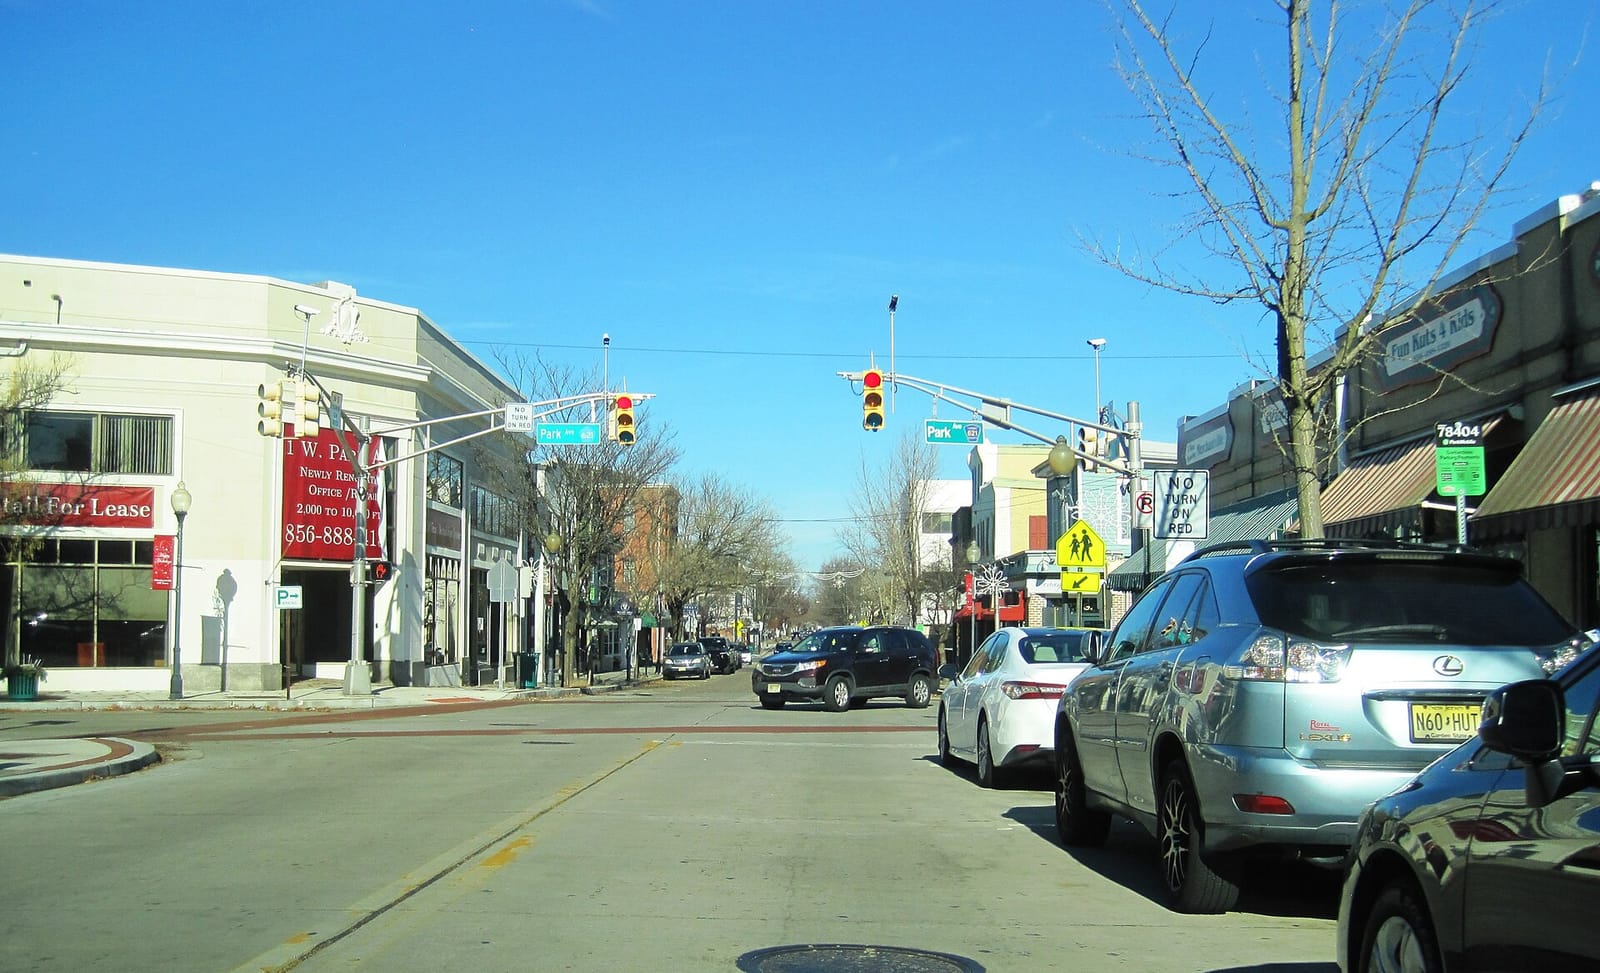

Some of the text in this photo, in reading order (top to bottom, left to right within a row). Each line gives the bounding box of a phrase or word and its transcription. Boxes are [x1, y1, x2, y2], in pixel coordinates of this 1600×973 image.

[1391, 342, 1410, 358] Fun
[1412, 328, 1437, 351] Kuts
[1439, 321, 1446, 338] 4
[1449, 309, 1474, 335] Kids
[540, 428, 562, 439] Park
[927, 425, 952, 438] Park
[1437, 425, 1480, 438] 78404
[287, 439, 294, 456] 1
[301, 440, 323, 459] W.
[1169, 476, 1194, 490] NO
[1165, 494, 1197, 504] TURN
[45, 496, 85, 516] For
[90, 498, 151, 518] Lease
[296, 503, 322, 516] 2,000
[1172, 508, 1190, 519] ON
[1169, 523, 1193, 534] RED
[1416, 712, 1478, 731] N60 HUT
[1299, 733, 1352, 741] LEXUS
